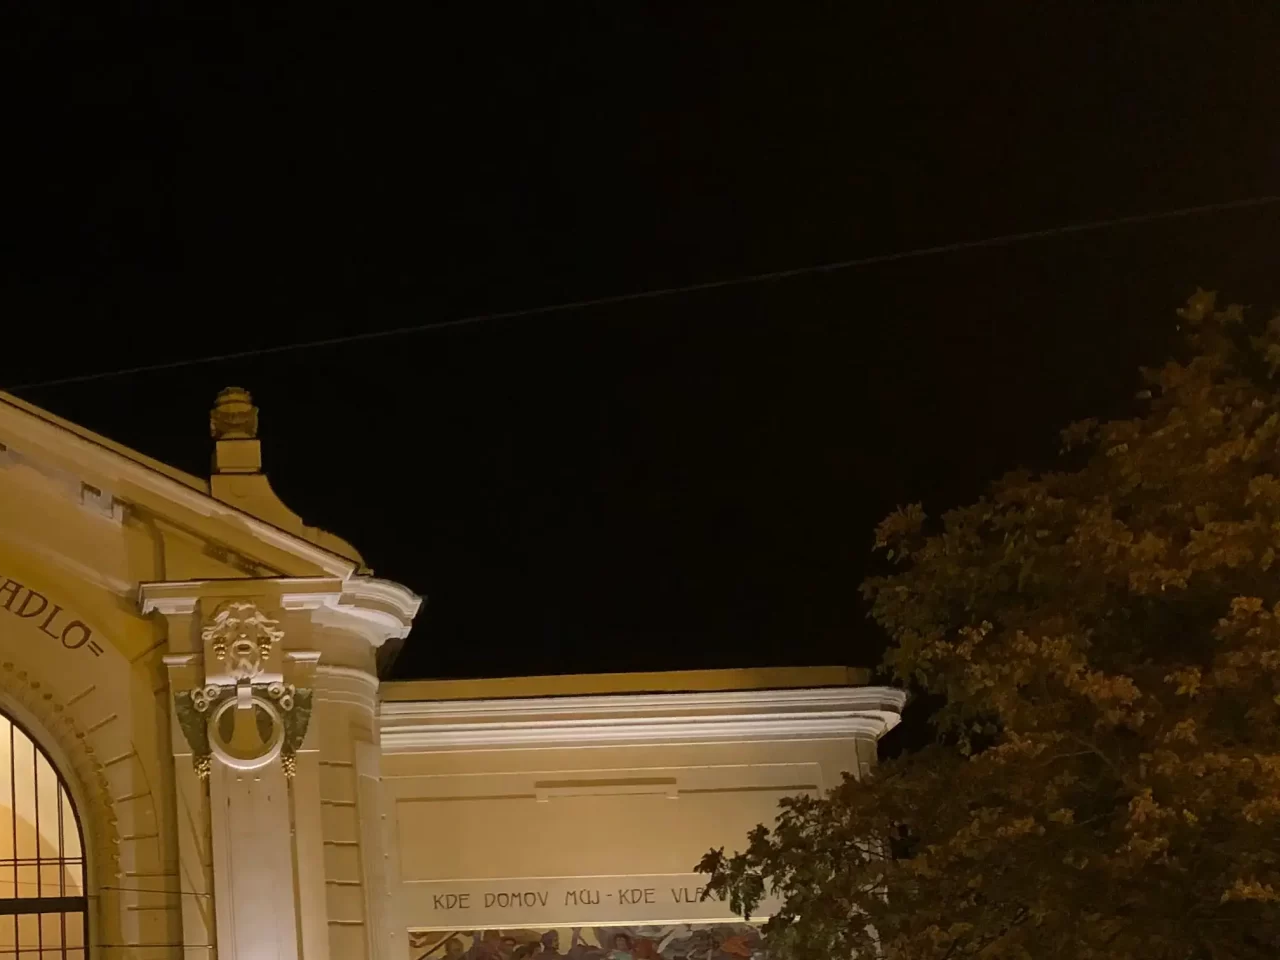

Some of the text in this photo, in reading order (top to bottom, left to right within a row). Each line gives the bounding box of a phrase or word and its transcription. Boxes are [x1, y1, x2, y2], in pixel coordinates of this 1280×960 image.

[433, 893, 470, 910] KDE
[484, 891, 549, 909] DOMOV
[618, 888, 655, 904] KDE
